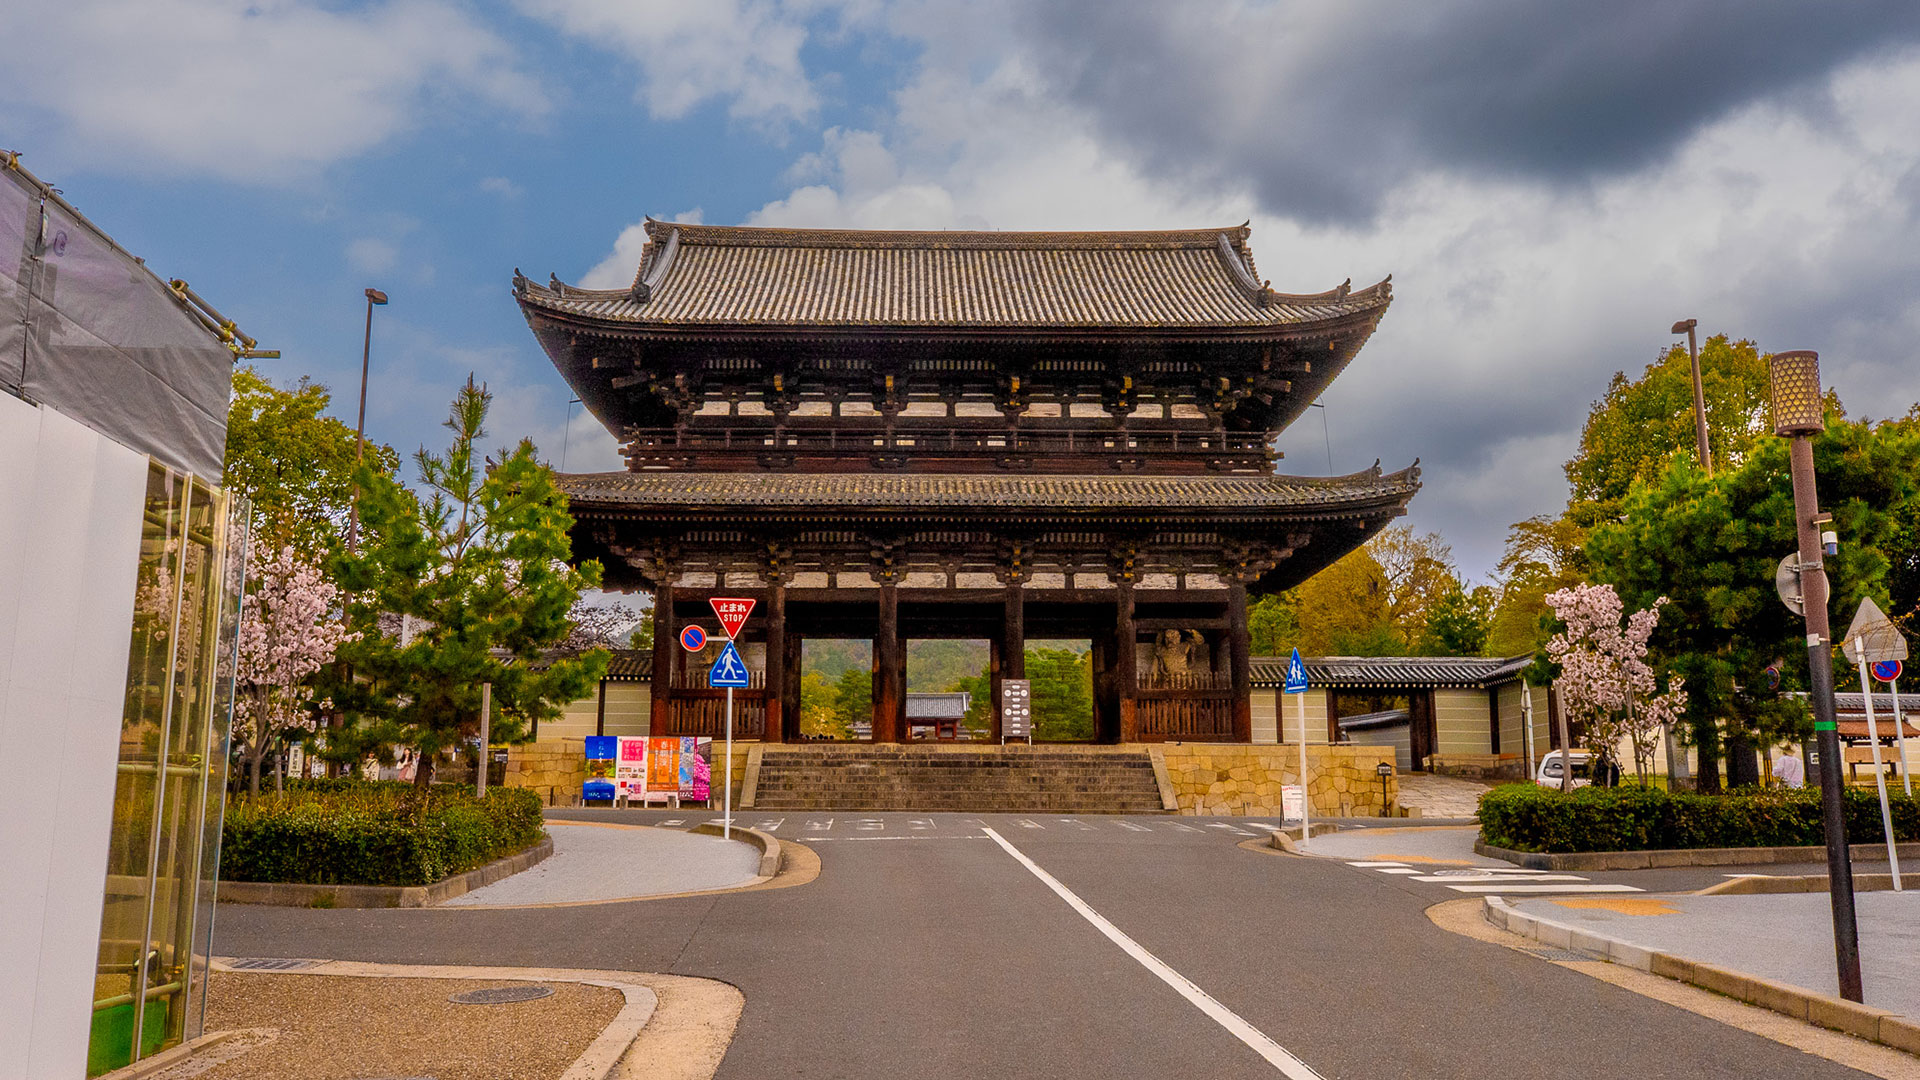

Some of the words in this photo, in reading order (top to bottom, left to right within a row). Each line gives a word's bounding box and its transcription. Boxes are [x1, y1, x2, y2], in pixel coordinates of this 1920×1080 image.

[719, 603, 746, 612] 止まれ
[724, 614, 743, 622] STOP
